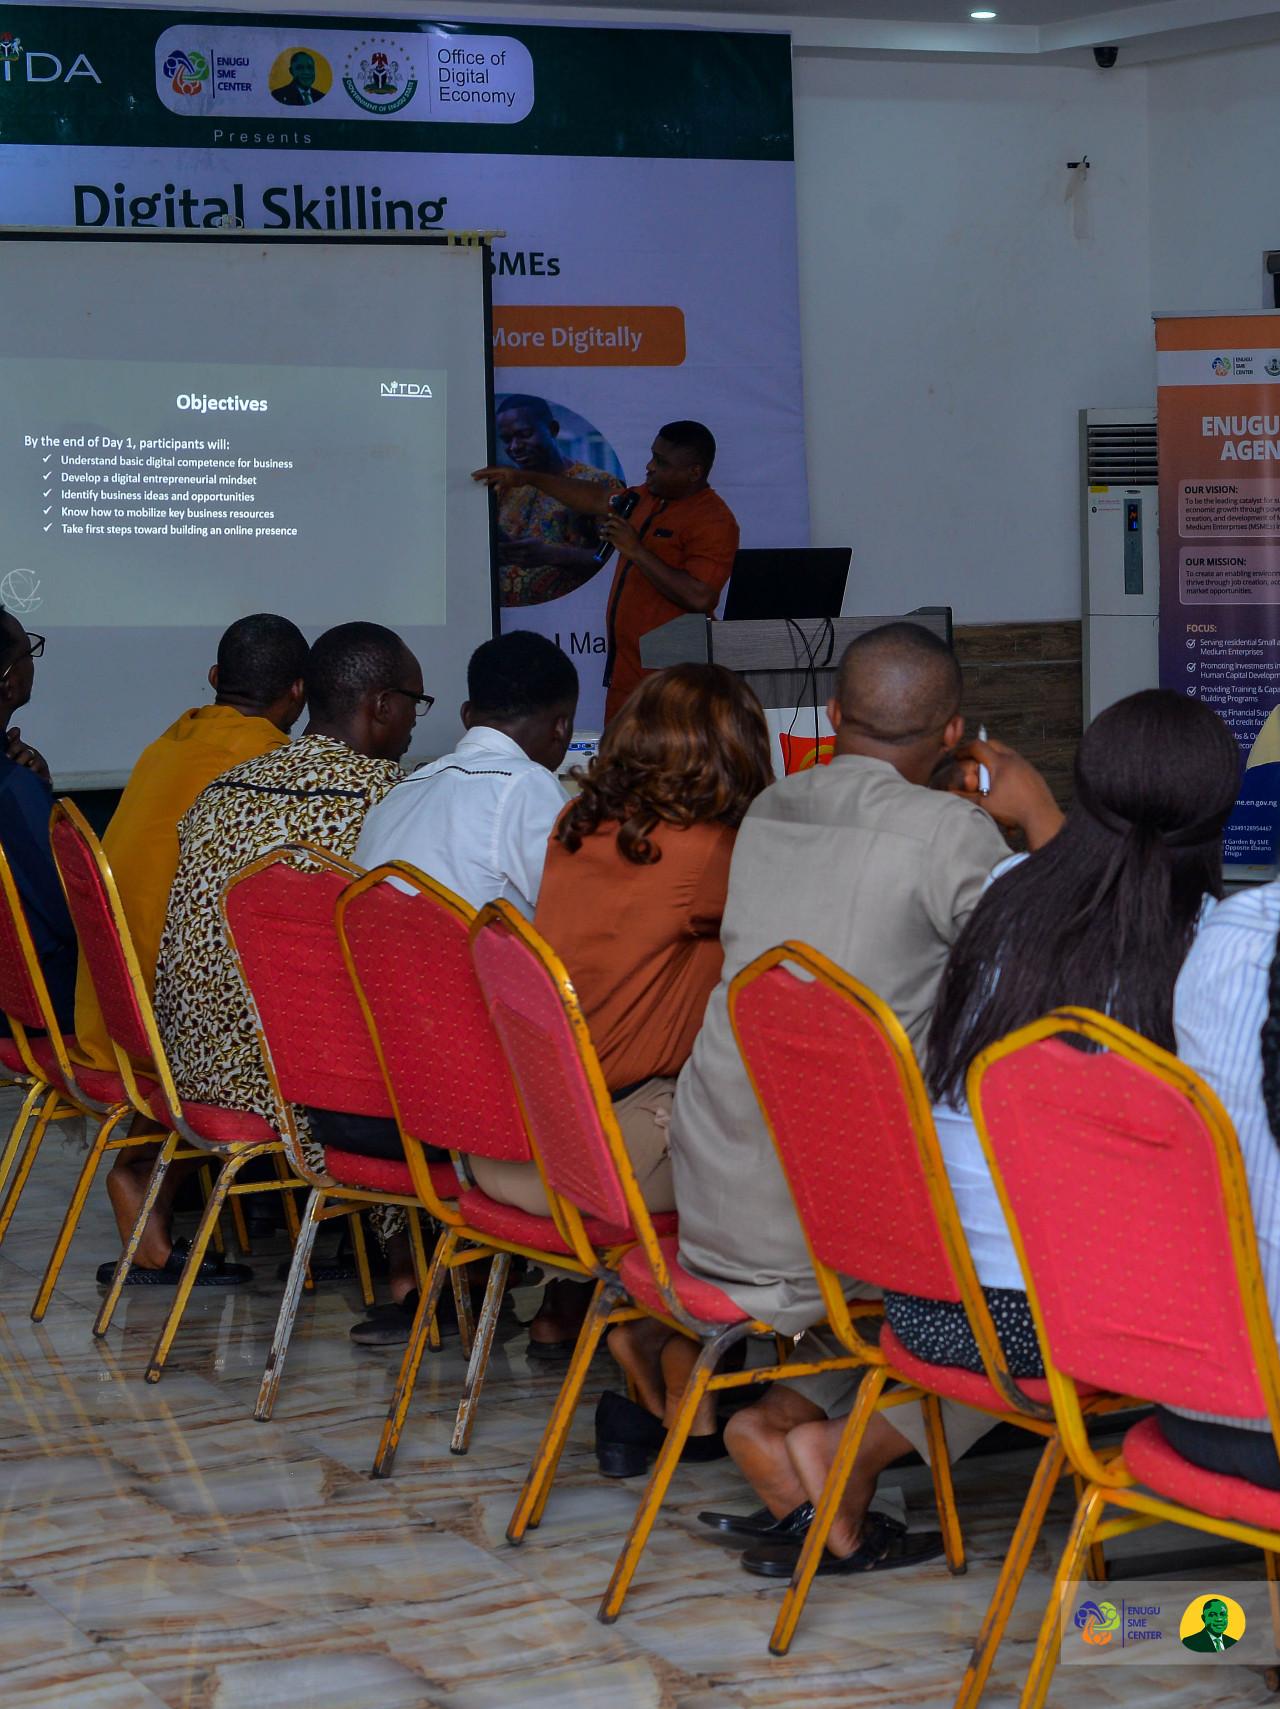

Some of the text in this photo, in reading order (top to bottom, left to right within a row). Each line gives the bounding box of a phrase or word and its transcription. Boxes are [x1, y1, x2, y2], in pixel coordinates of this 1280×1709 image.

[217, 57, 249, 67] ENUGU
[438, 49, 506, 66] Office of
[217, 70, 236, 79] SME
[439, 67, 489, 87] Digital
[217, 82, 252, 92] CENTER
[439, 87, 516, 107] Economy
[214, 129, 312, 144] Presents
[74, 182, 448, 230] Digital Skilling
[551, 326, 643, 354] Digitally
[176, 393, 268, 413] Objectives
[1202, 415, 1279, 437] ENUGU
[24, 436, 230, 450] By the end of Day 1, participants will:
[61, 455, 293, 470] Understand basic digital competence for business
[62, 473, 100, 484] Develop
[111, 474, 140, 486] digital
[143, 475, 216, 487] entrepreneurial
[219, 476, 257, 485] mindset
[1184, 486, 1239, 494] OUR VISION:
[62, 490, 254, 504] Identify business ideas and opportunities
[1239, 497, 1262, 506] catalyst
[62, 507, 274, 520] Know how to mobilize key business resources
[1216, 506, 1239, 514] growth
[1240, 506, 1264, 514] through
[62, 524, 297, 538] Take first steps toward building an online presence
[1212, 524, 1248, 532] Enterprises
[1186, 558, 1247, 566] OUR MISSION:
[1224, 570, 1252, 578] enabling
[1206, 579, 1230, 588] through
[1231, 579, 1242, 587] job
[1186, 624, 1218, 633] FOCUS:
[1200, 639, 1223, 648] Serving
[1228, 648, 1264, 656] Enterprises
[1200, 662, 1234, 671] Promoting
[1226, 672, 1248, 680] Capital
[1200, 686, 1230, 695] Providing
[1231, 686, 1257, 695] Training
[1200, 695, 1258, 704] Building Programs
